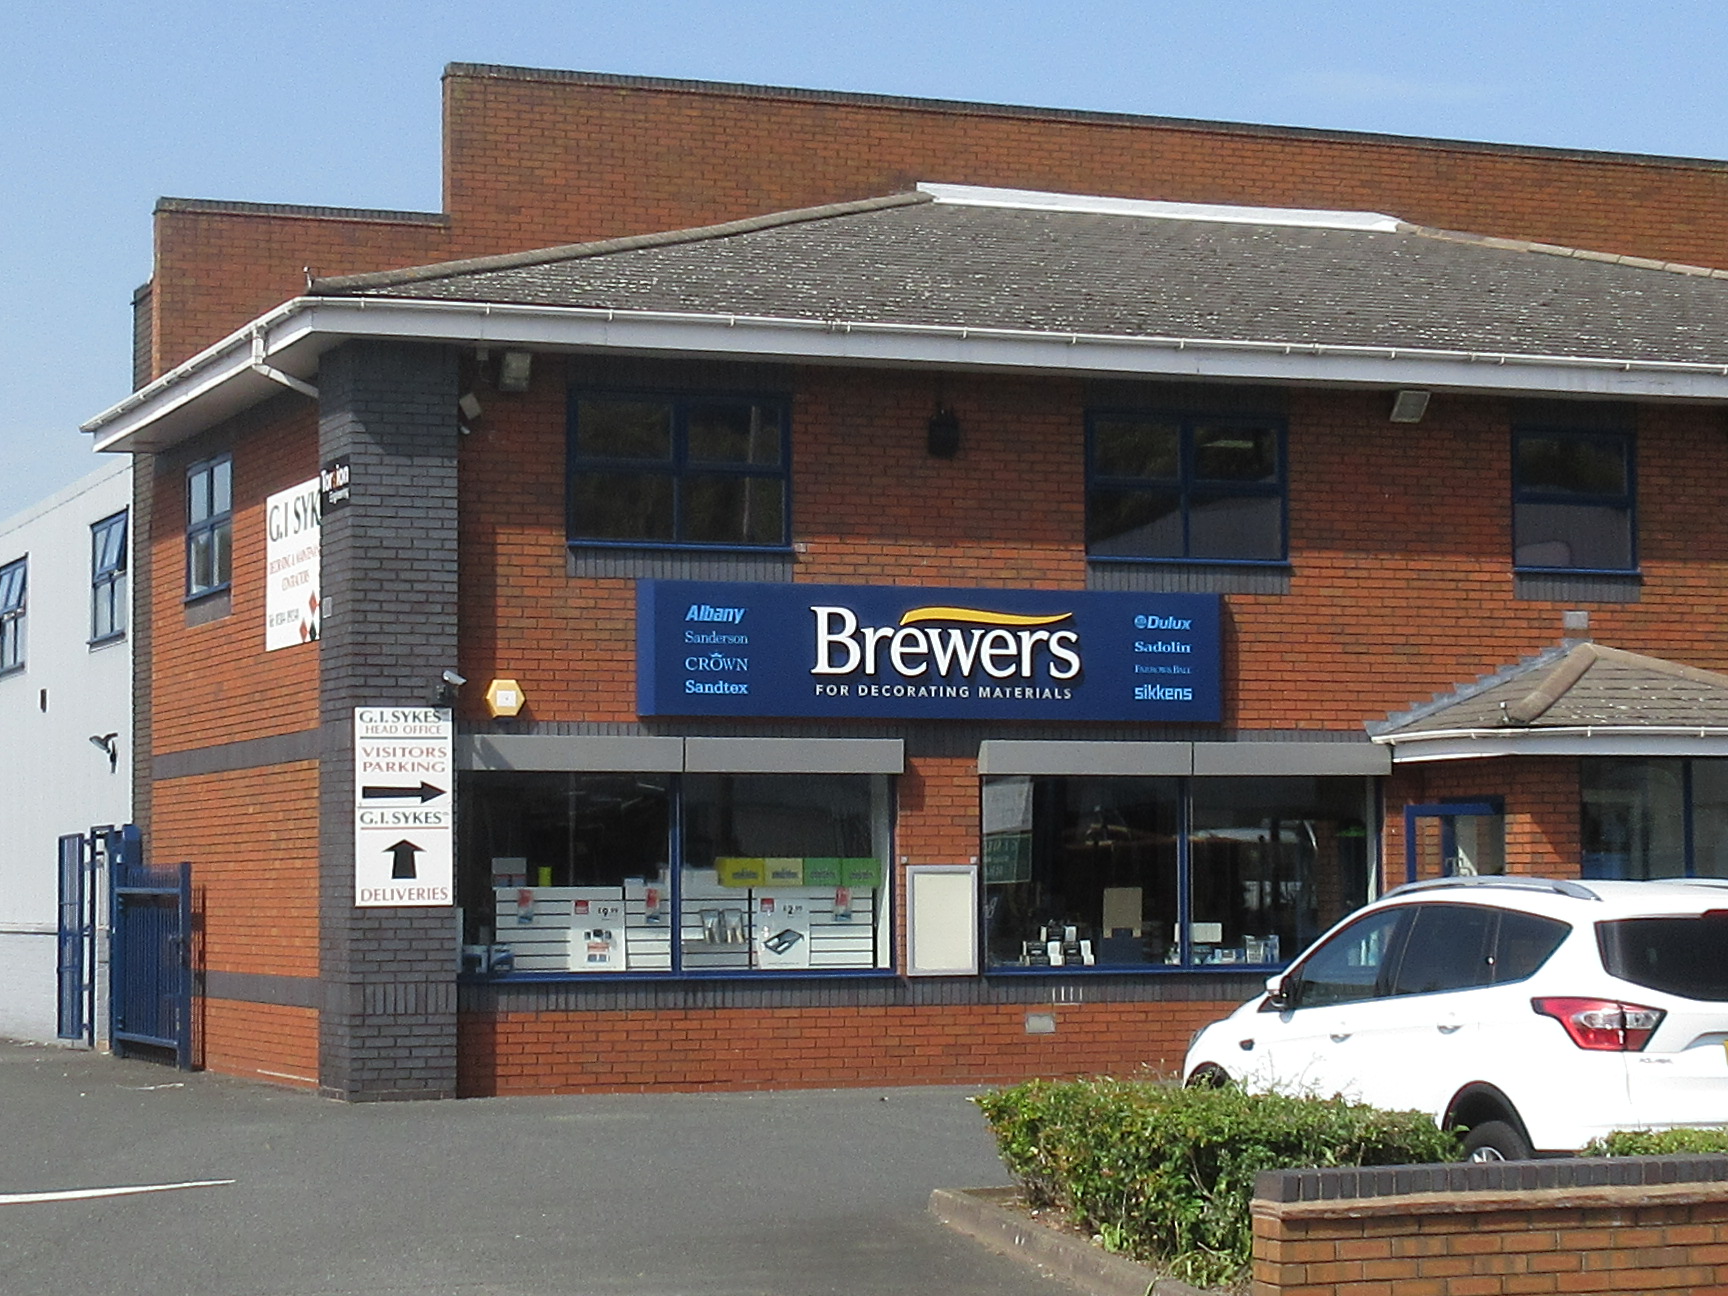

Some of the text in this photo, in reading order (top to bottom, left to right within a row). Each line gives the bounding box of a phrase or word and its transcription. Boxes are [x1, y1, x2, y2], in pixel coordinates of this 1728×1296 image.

[685, 605, 746, 624] Albany
[1147, 615, 1192, 630] Dulux
[685, 630, 748, 645] Sanderson
[810, 605, 1081, 680] Brewers
[1135, 641, 1192, 653] Sadolin
[685, 656, 749, 672] CROWN
[685, 679, 749, 695] Sandtex
[815, 684, 1072, 700] FOR DECORATING MATERIALS
[1135, 684, 1193, 701] sikkens
[365, 724, 442, 735] HEAD OFFICE
[362, 747, 447, 758] VISITORS
[363, 761, 446, 773] PARKING
[361, 887, 448, 902] DELIVERIES
